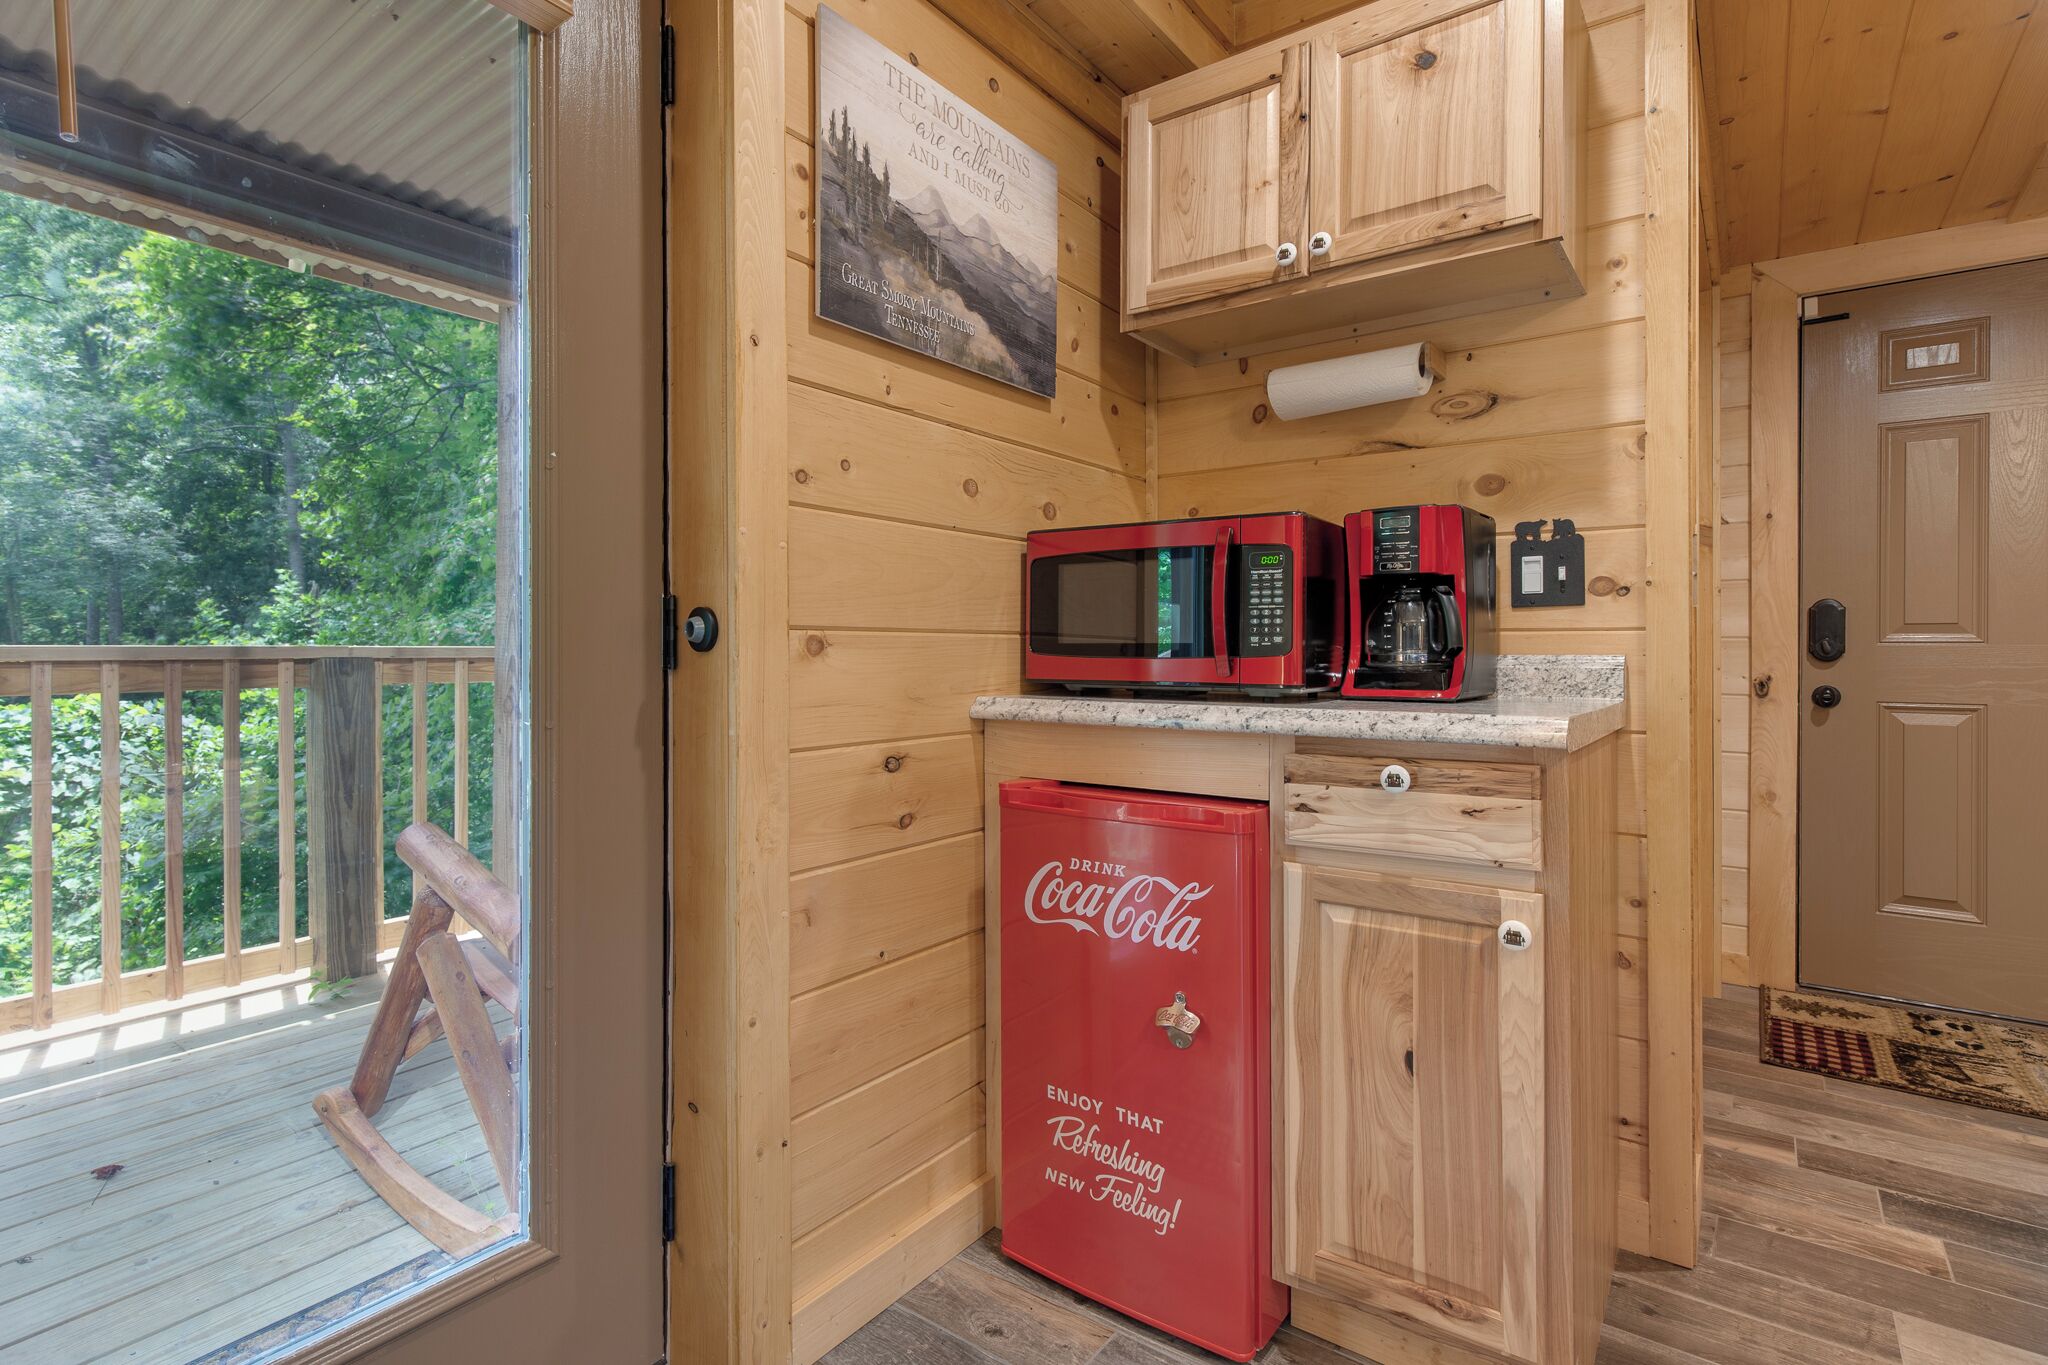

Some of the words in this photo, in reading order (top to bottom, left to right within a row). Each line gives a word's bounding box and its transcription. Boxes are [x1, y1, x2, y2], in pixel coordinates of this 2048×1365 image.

[884, 61, 926, 110] THE
[931, 93, 1031, 179] MOUNTAINS
[906, 111, 946, 151] are
[953, 145, 1022, 210] calling
[908, 142, 939, 171] AND
[943, 162, 950, 179] I
[955, 169, 991, 202] MUST
[842, 262, 879, 295] GREAT
[881, 279, 917, 311] SMOKY
[1261, 555, 1279, 564] 0:00
[1069, 857, 1127, 877] DRINK
[1047, 1084, 1103, 1115] ENJOY
[1115, 1106, 1164, 1134] THAT
[1047, 1116, 1166, 1193] Refreshing
[1045, 1167, 1085, 1192] NEW
[1089, 1174, 1182, 1235] Feeling!
